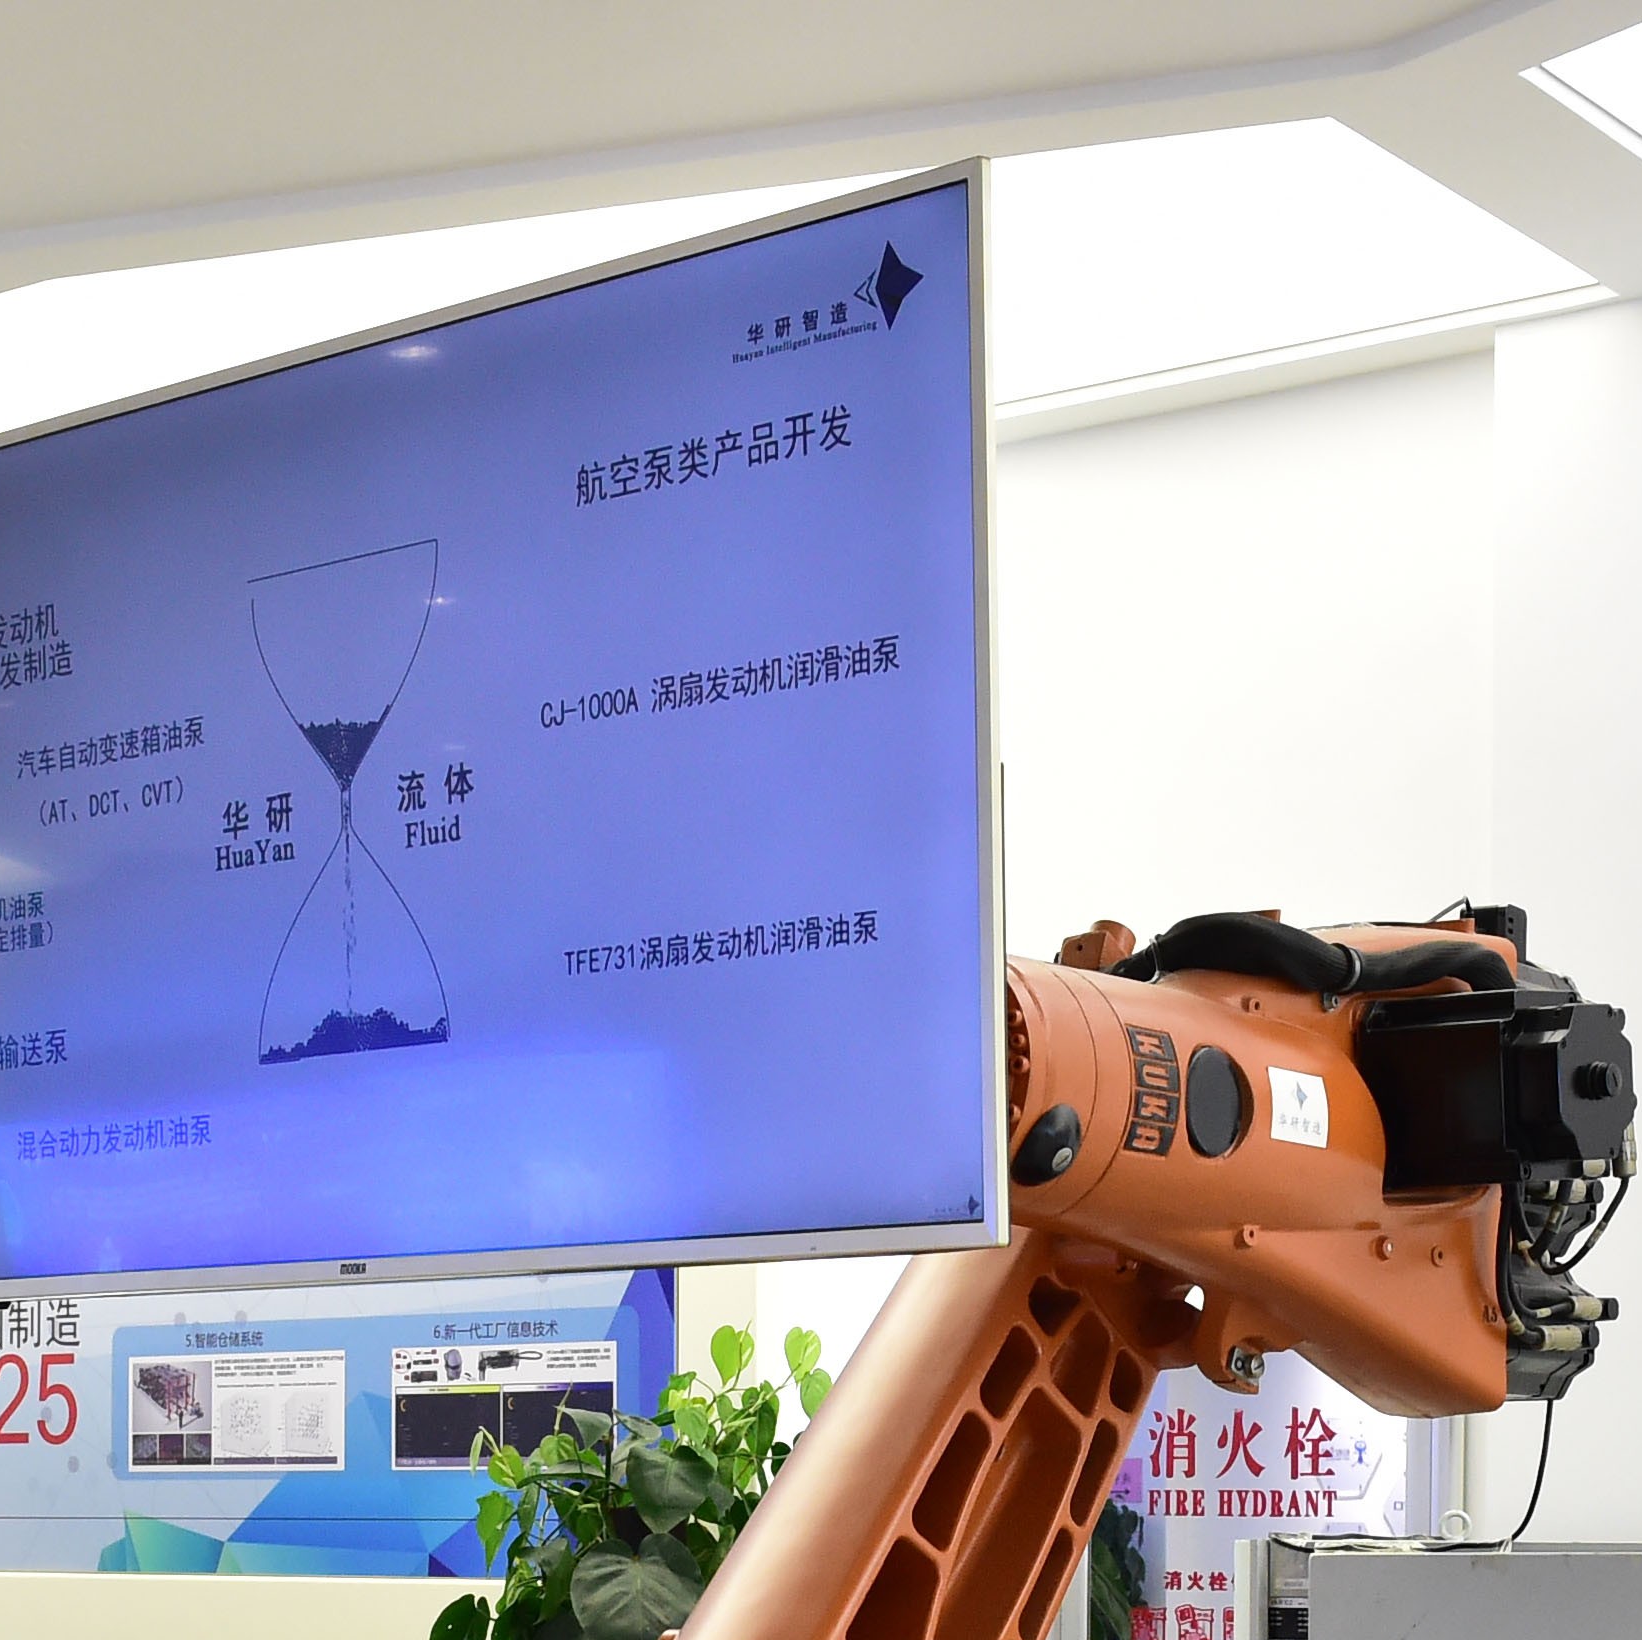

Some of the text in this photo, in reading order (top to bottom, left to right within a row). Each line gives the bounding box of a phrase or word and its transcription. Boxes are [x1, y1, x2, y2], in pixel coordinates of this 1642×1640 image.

[746, 301, 849, 345] 华研智造
[766, 334, 811, 358] Intelligent
[813, 319, 878, 345] Manufacturing
[575, 404, 853, 508] 航空泵类产品开发
[540, 634, 901, 729] CJ-1000A 涡扇发动机润滑油泵
[17, 716, 206, 779] 汽车自动变速箱油泵
[397, 762, 476, 812] 流体
[222, 793, 295, 841] 华研
[404, 814, 462, 849] Fluid
[215, 838, 296, 873] HuaYan
[564, 910, 879, 977] TFE731涡扇发动机润滑油泵
[1129, 1028, 1175, 1153] KUKA
[16, 1114, 214, 1162] 混合动力发动机油泵
[185, 1331, 264, 1349] 5.智能仓储系统
[433, 1322, 559, 1341] 6.新一代工厂信息技术
[1148, 1407, 1337, 1480] 消火栓
[1147, 1488, 1338, 1519] FIRE HYDRANT
[1163, 1570, 1234, 1591] 消火栓
